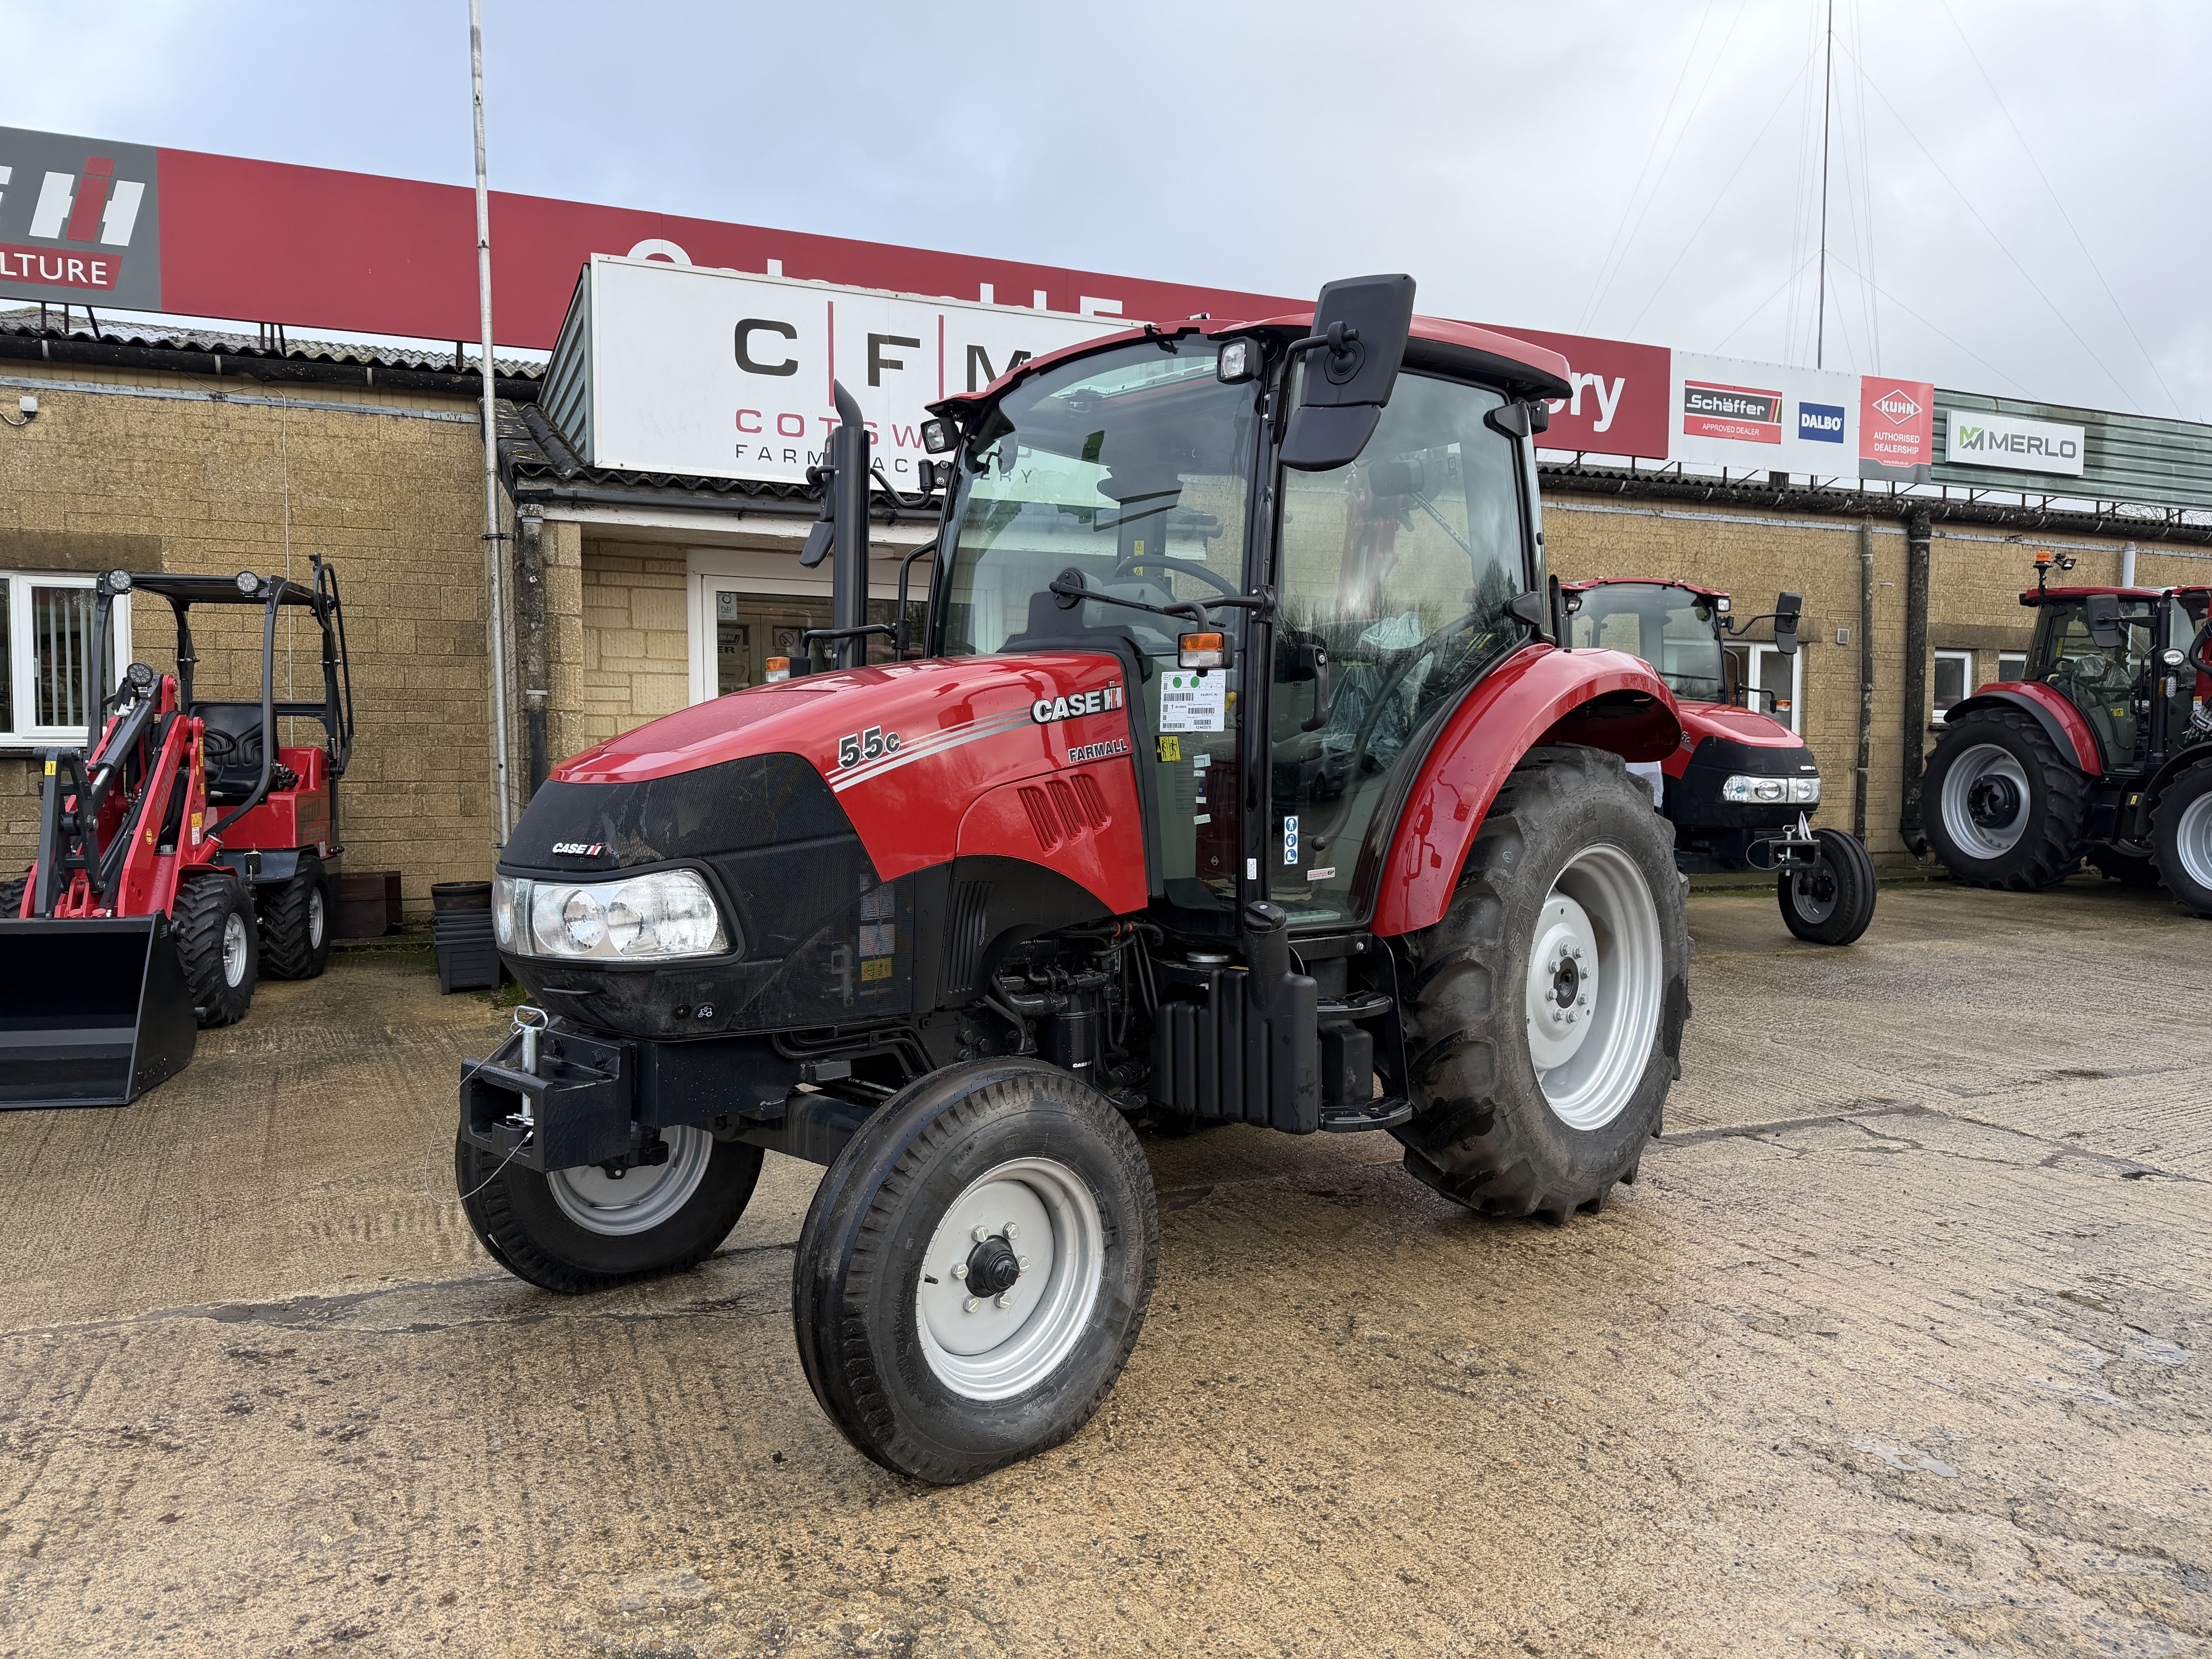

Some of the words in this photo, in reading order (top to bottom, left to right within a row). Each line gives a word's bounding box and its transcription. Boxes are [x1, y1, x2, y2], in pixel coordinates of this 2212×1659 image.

[1686, 394, 1765, 416] Schäffer
[1881, 400, 1914, 416] KUHN
[1702, 423, 1735, 433] APPROVED
[1736, 426, 1760, 436] DEALER
[1802, 414, 1841, 431] DALBO
[1874, 431, 1920, 444] AUTHORISED
[1989, 431, 2076, 459] MERLO
[1874, 443, 1919, 455] DEALERSHIP
[1033, 692, 1101, 723] CASE
[1068, 738, 1128, 763] FARMALL
[552, 843, 586, 854] CASE
